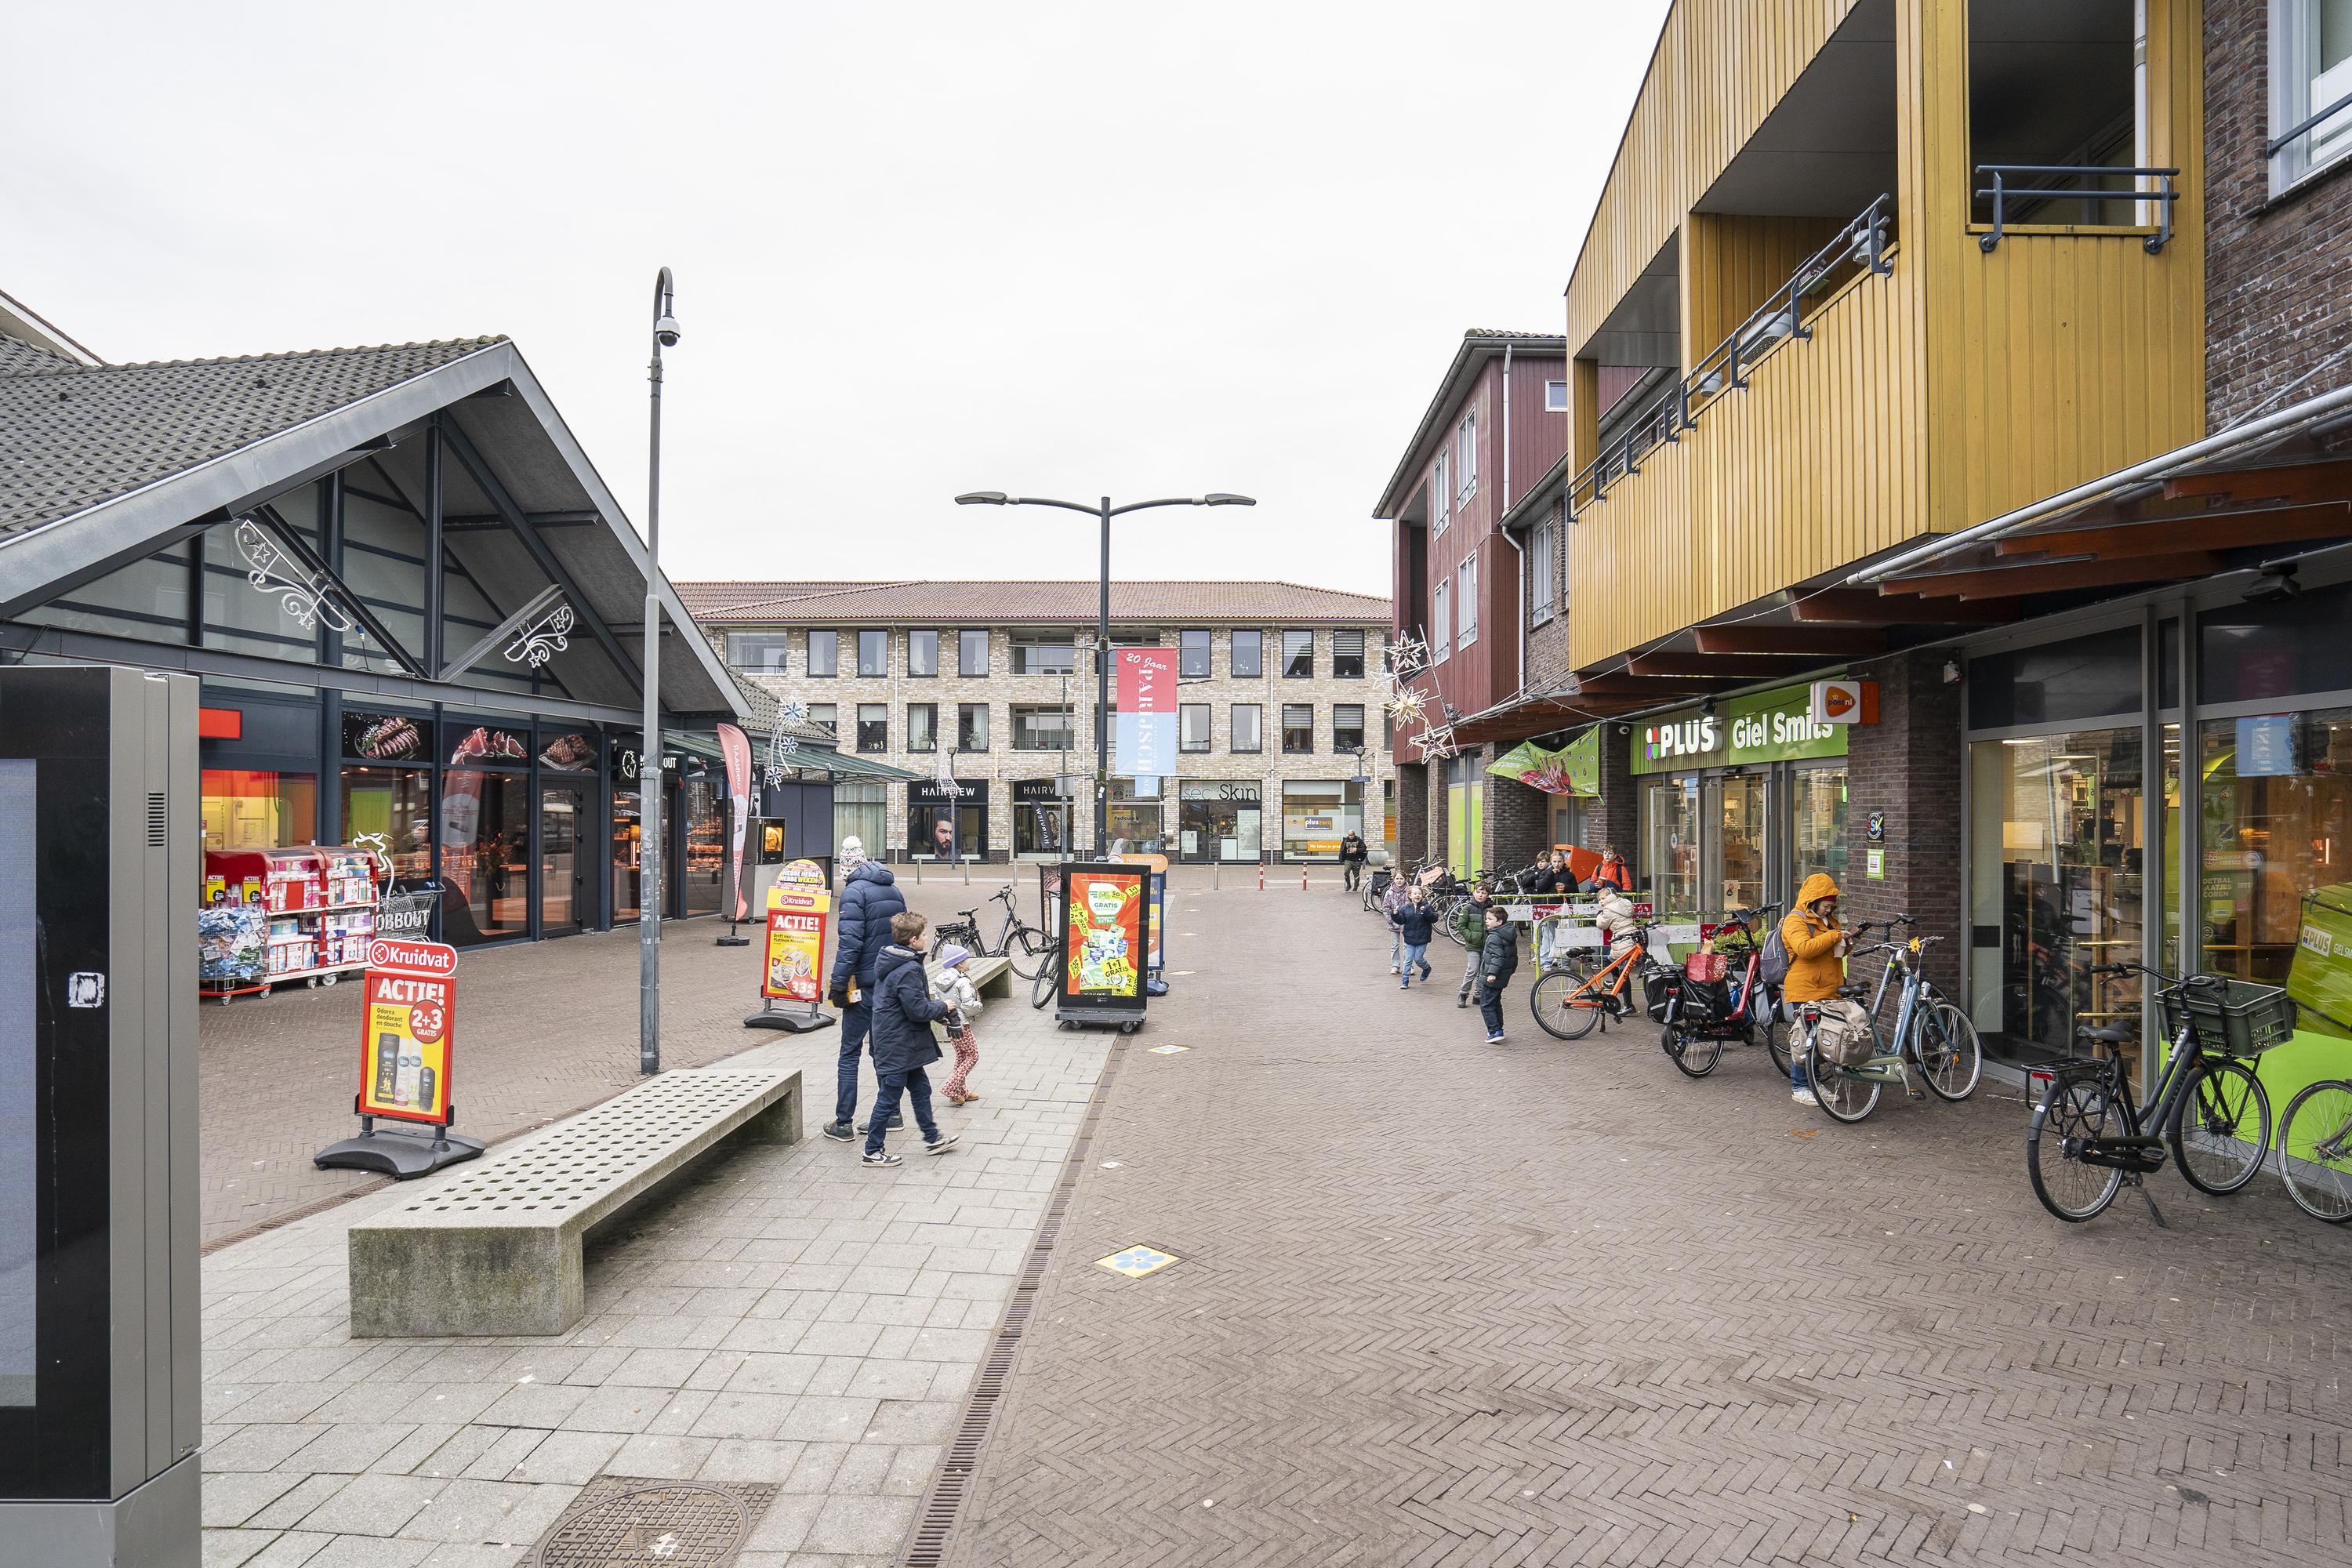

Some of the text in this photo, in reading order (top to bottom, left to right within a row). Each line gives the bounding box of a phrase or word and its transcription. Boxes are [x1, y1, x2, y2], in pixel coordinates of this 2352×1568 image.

[1126, 652, 1167, 671] 20 Jaar
[1138, 667, 1154, 772] PARIJSCH
[1661, 716, 1715, 758] PLUS
[1732, 713, 1768, 750] Giel
[640, 754, 677, 769] KOUT
[1023, 786, 1055, 794] HAIRV
[1219, 783, 1258, 800] Skin
[787, 897, 813, 906] Kruidvat
[376, 909, 430, 931] ORBOUT
[774, 914, 819, 931] ACTIE!
[2308, 931, 2330, 953] PLUS
[389, 946, 450, 968] Kruidvat
[1106, 959, 1123, 971] 1+1
[1105, 966, 1130, 978] GRATIS
[377, 978, 445, 1007] ACTIE!
[376, 1007, 395, 1015] Odorex
[376, 1014, 403, 1022] deodorant
[412, 1008, 442, 1030] 2+3
[416, 1028, 437, 1037] GRATIS
